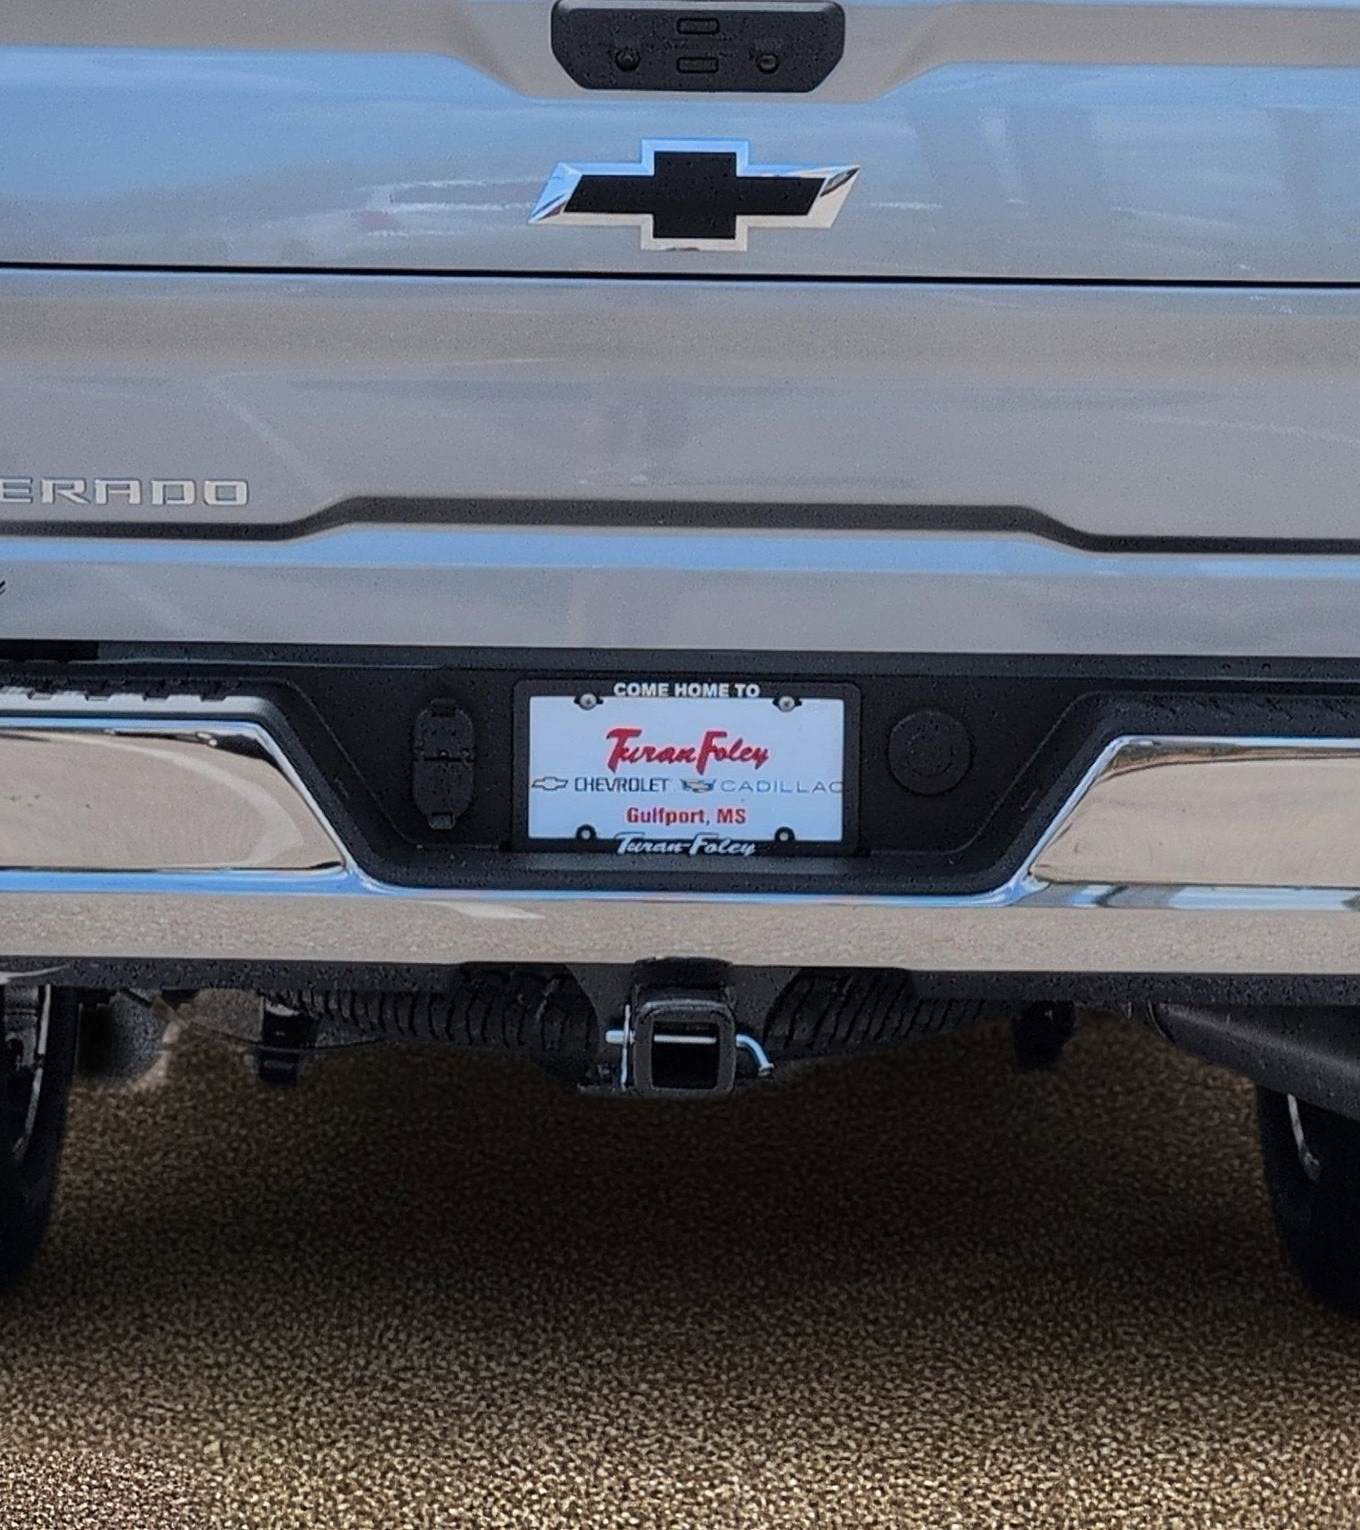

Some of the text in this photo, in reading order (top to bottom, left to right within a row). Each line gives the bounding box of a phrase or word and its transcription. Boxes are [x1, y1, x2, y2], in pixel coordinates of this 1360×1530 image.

[613, 682, 761, 698] COME HOME TO
[606, 728, 769, 776] Turan Foley
[574, 777, 844, 794] CHEVROLET CADILLAC
[626, 806, 747, 826] Gulfport, MS
[614, 831, 756, 857] Turan-Foley
